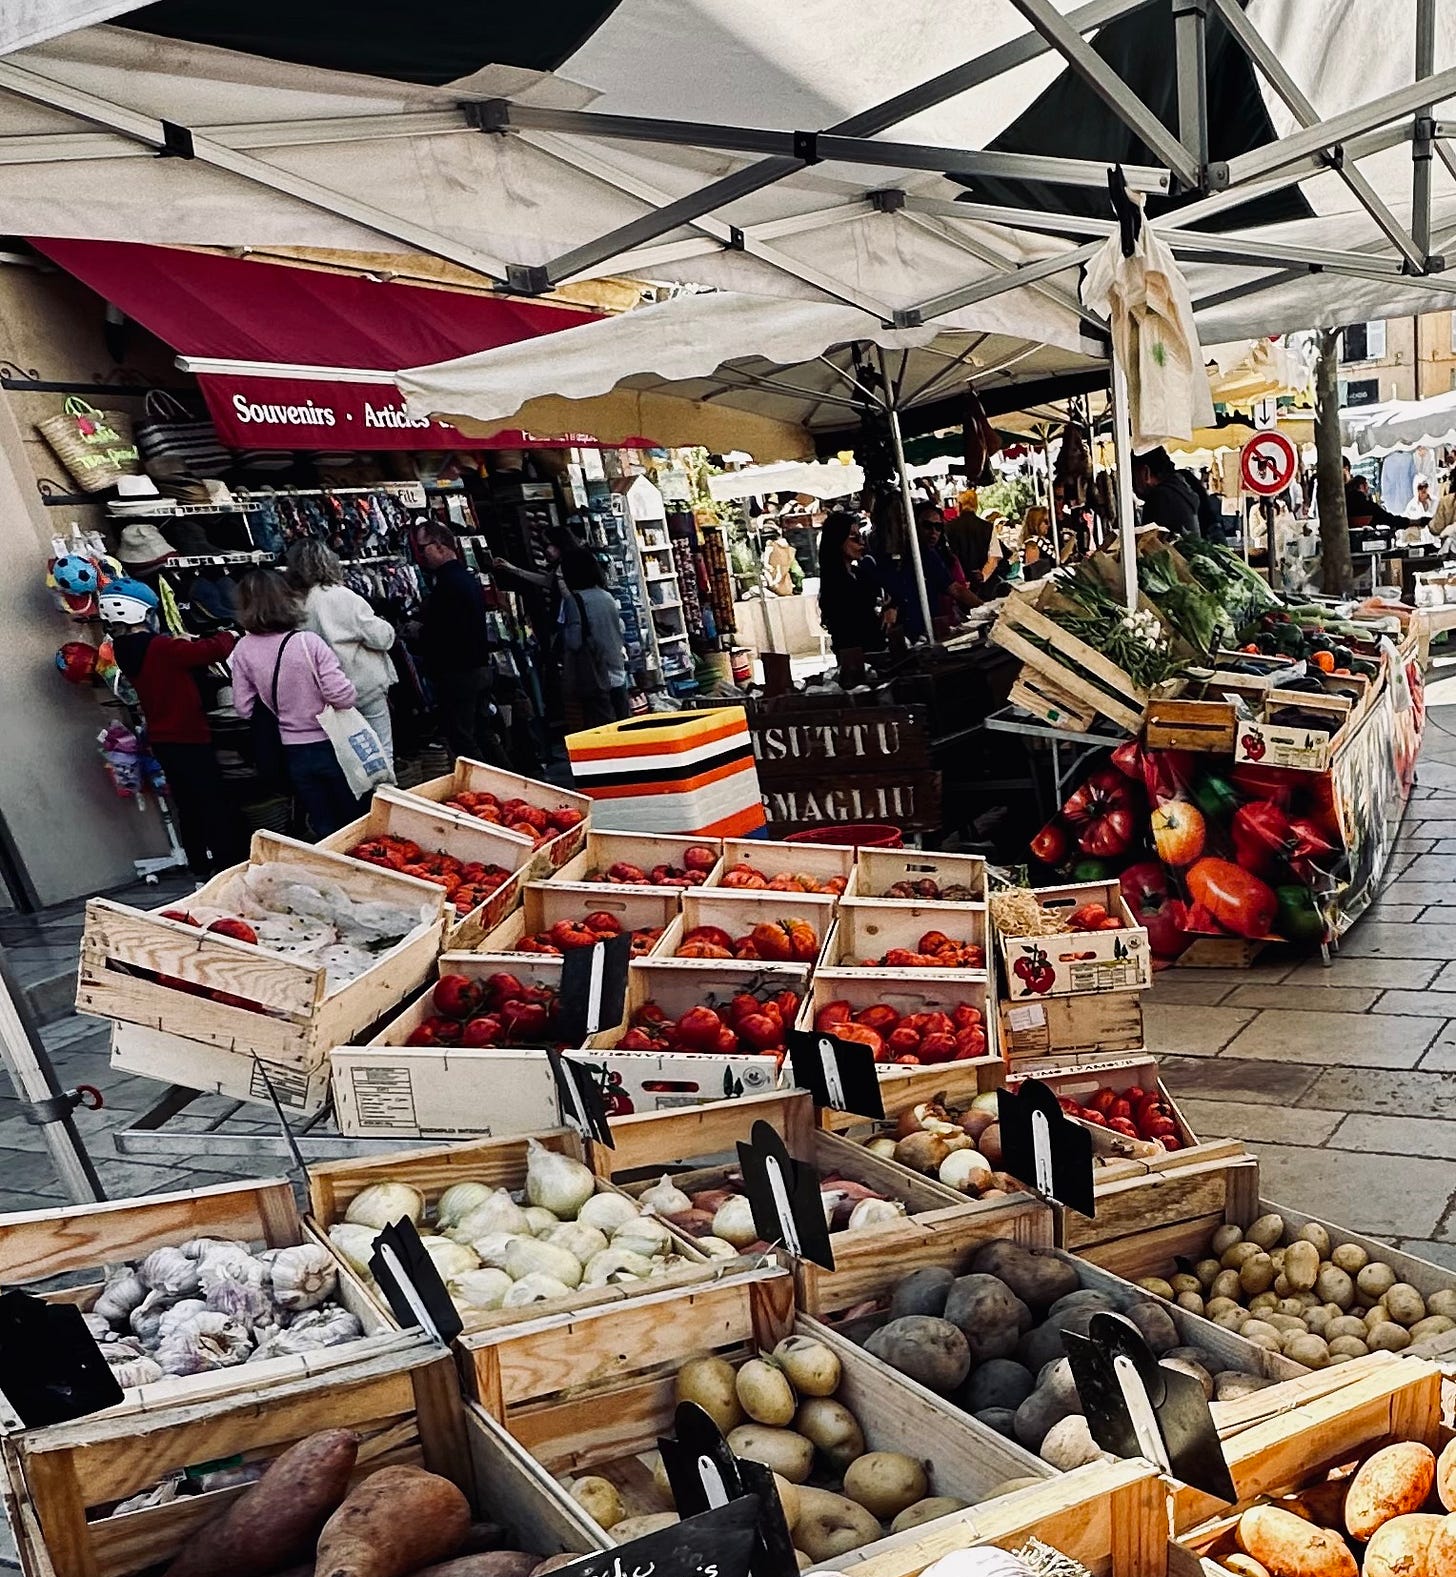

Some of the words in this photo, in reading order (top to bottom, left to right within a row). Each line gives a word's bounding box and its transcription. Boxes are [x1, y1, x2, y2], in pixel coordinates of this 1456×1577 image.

[232, 394, 336, 427] Souvenirs
[751, 722, 900, 761] ISUTTU
[761, 786, 914, 822] RMAGLIU
